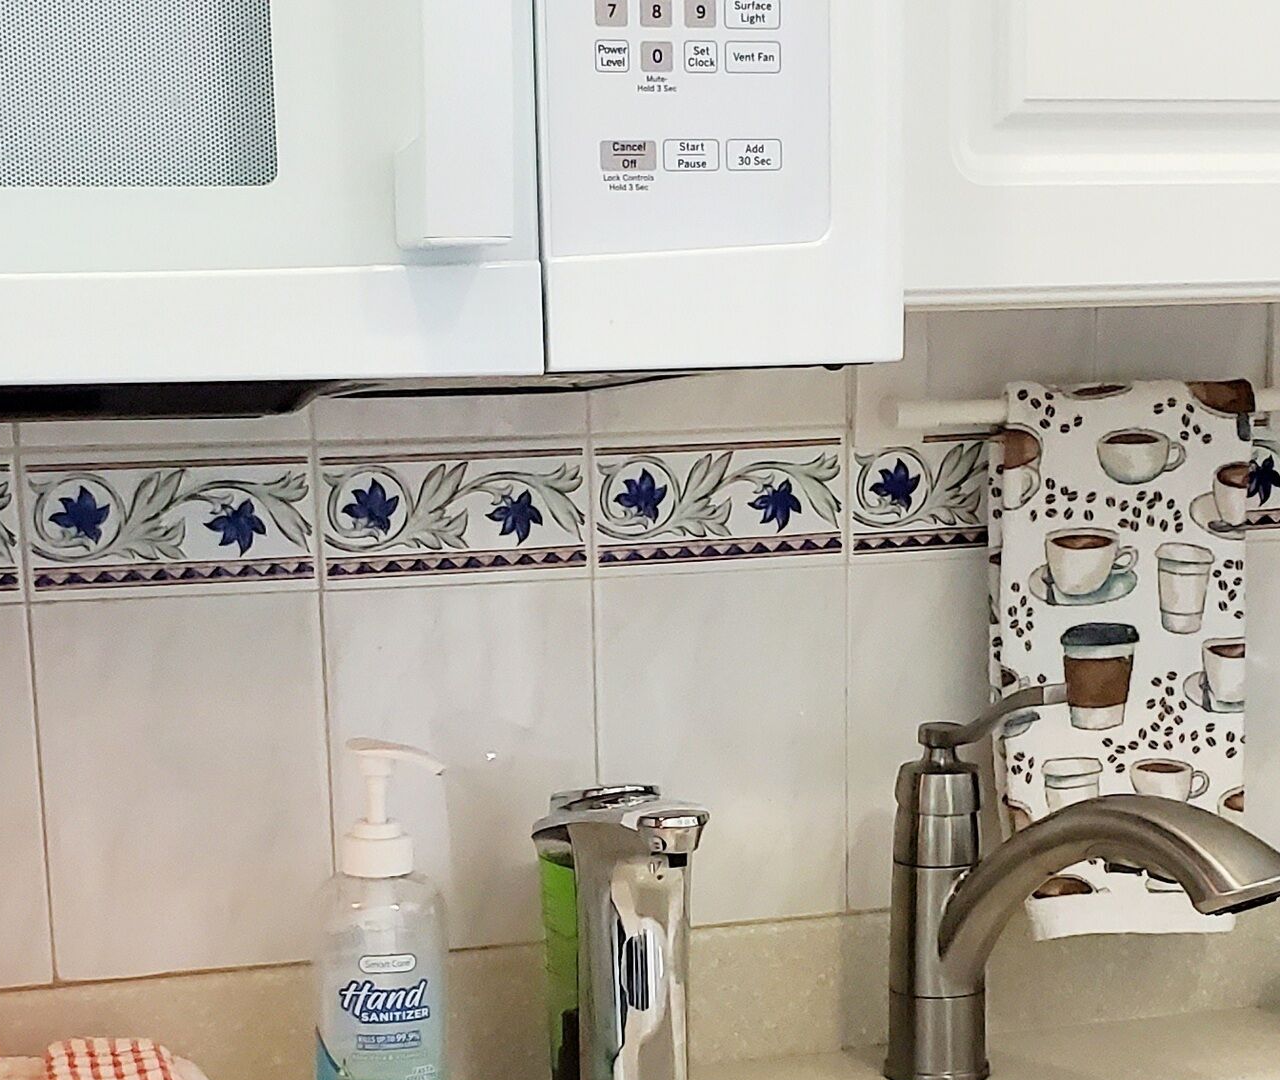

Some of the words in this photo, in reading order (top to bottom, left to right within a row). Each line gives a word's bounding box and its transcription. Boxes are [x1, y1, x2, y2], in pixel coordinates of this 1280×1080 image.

[607, 3, 617, 18] 7
[734, 1, 772, 11] Surface
[652, 4, 662, 19] 8
[696, 4, 706, 19] 9
[740, 13, 766, 25] Light
[597, 44, 627, 55] Power
[693, 46, 710, 56] Set
[652, 48, 663, 64] 0
[733, 52, 755, 62] Vent
[757, 52, 775, 62] Fan
[600, 56, 626, 67] Level
[687, 57, 716, 67] Clock
[637, 84, 655, 92] Hold
[657, 84, 661, 92] 3
[664, 84, 677, 92] Sec
[612, 141, 646, 152] Cancel
[679, 142, 705, 152] Start
[745, 144, 764, 154] Add
[621, 158, 637, 169] Off
[677, 159, 707, 169] Pause
[738, 156, 752, 166] 30
[753, 156, 772, 166] Sec
[603, 174, 620, 182] Lock
[622, 174, 655, 182] Controls
[609, 183, 627, 191] Hold
[629, 183, 633, 191] 3
[635, 183, 649, 191] Sec
[339, 979, 428, 1017] Hand
[361, 1007, 429, 1022] SANITIZER
